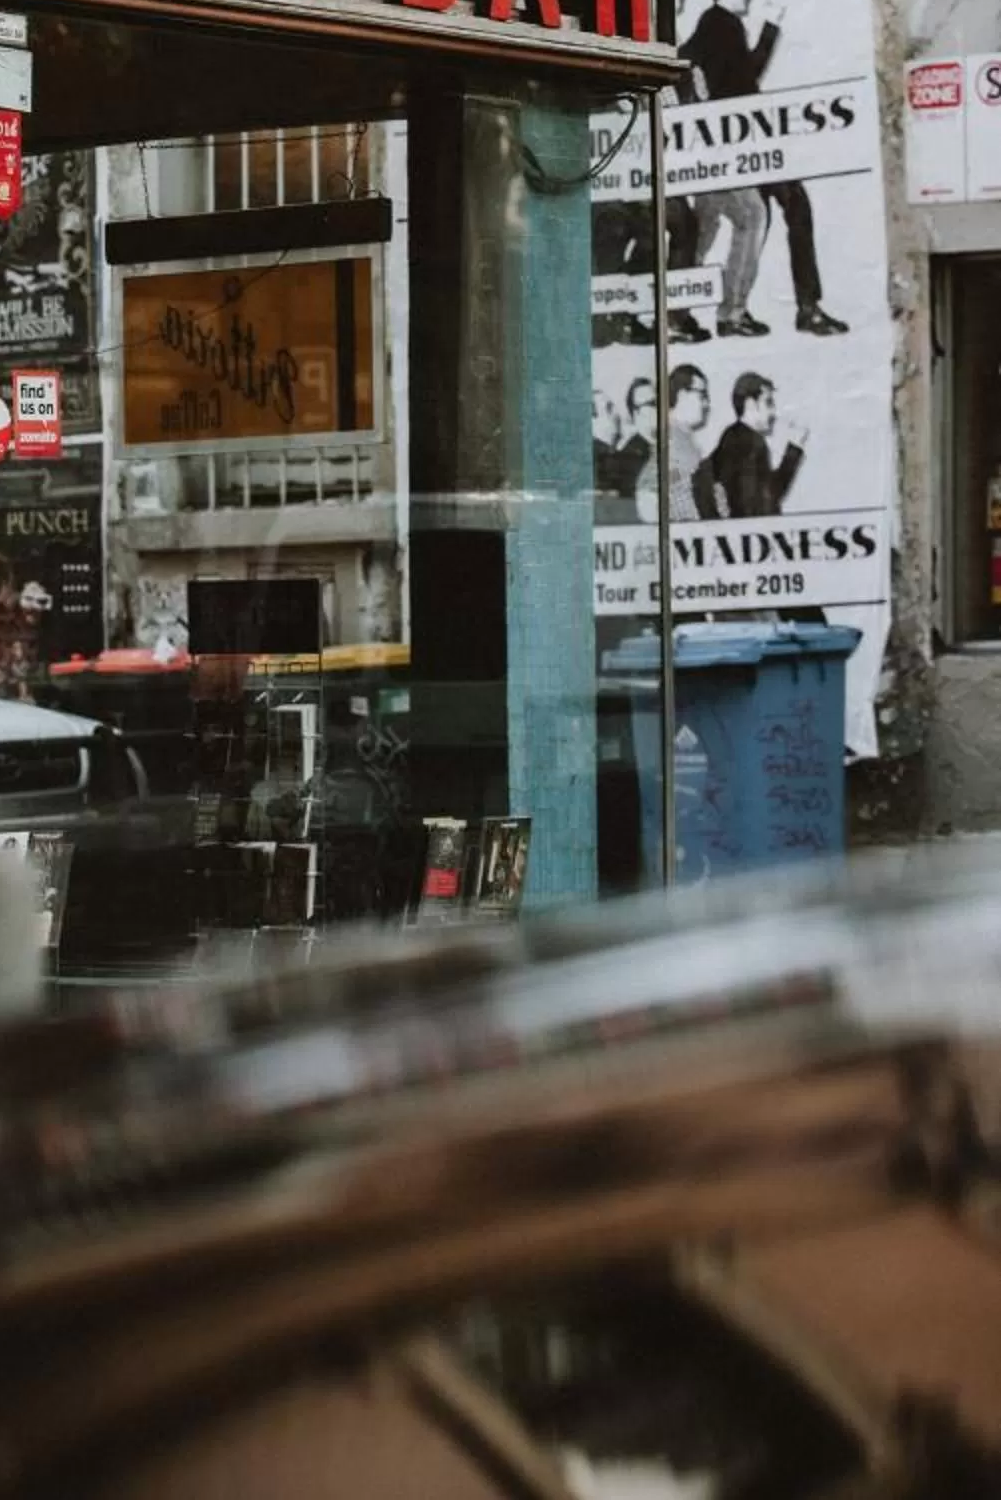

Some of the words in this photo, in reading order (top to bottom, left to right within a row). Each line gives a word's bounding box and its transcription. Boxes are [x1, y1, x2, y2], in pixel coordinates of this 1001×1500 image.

[662, 95, 856, 152] MADNESS
[591, 173, 621, 190] our
[630, 158, 729, 189] Deember
[736, 149, 785, 175] 2019
[20, 382, 46, 399] find
[20, 403, 35, 415] us
[38, 403, 54, 415] on
[6, 508, 90, 536] PUNCH
[594, 540, 627, 573] ND
[672, 524, 878, 568] MADNESS
[595, 583, 640, 604] Tour
[648, 576, 748, 603] Dcember
[755, 572, 805, 596] 2019
